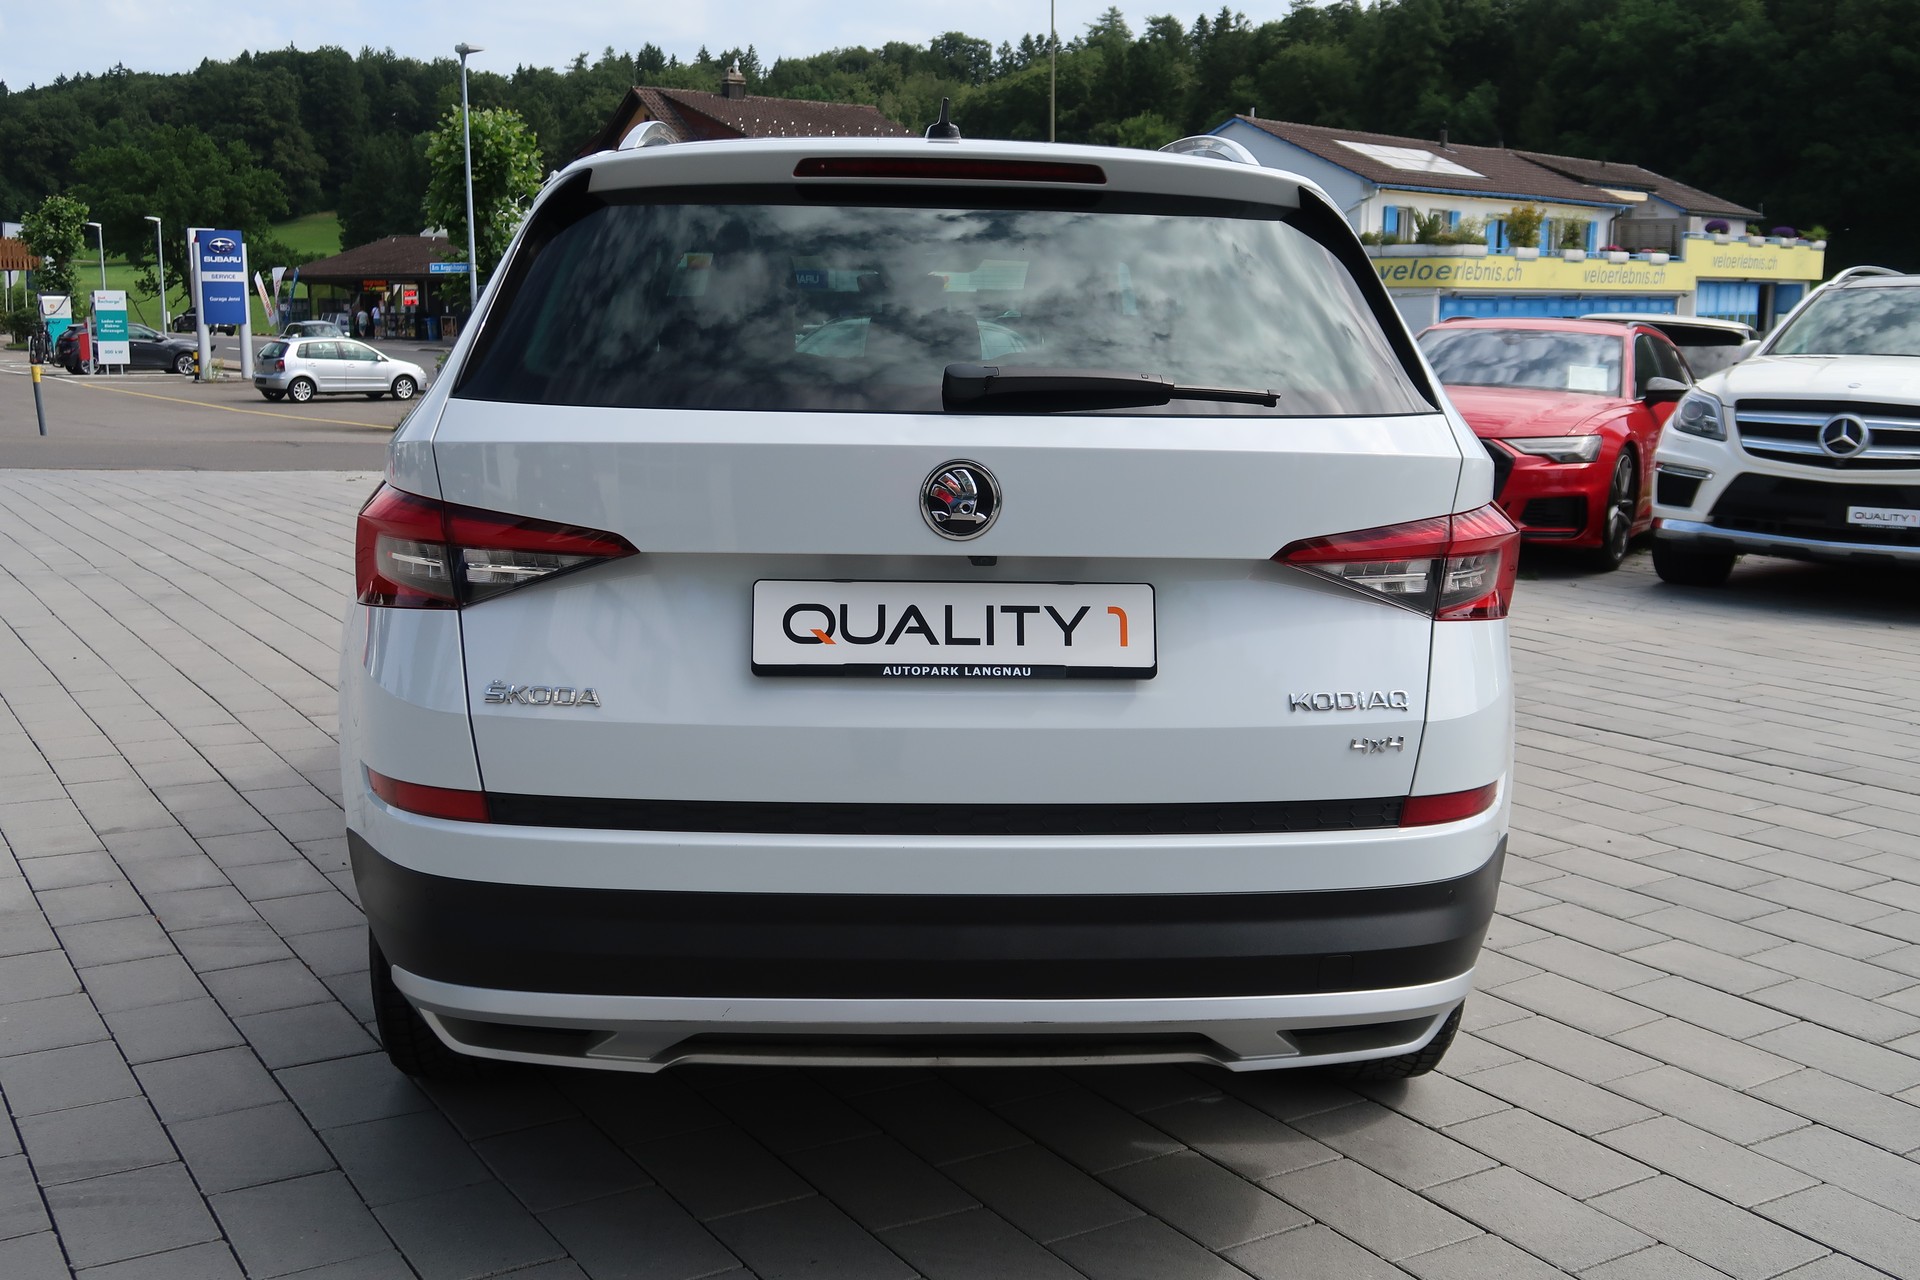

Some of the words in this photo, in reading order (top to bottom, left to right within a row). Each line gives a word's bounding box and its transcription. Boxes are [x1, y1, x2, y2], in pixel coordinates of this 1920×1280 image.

[1379, 259, 1523, 282] veloerlebnis.ch
[1712, 253, 1778, 271] veloerlebnis.ch
[1583, 266, 1666, 286] veloerlebnis.ch
[1854, 511, 1910, 523] QUALITY
[782, 603, 1091, 647] QUALITY
[1107, 606, 1128, 647] 1
[883, 666, 959, 677] AUTOPARK
[964, 666, 1032, 677] LANGNAU
[484, 680, 600, 707] ŠKODA
